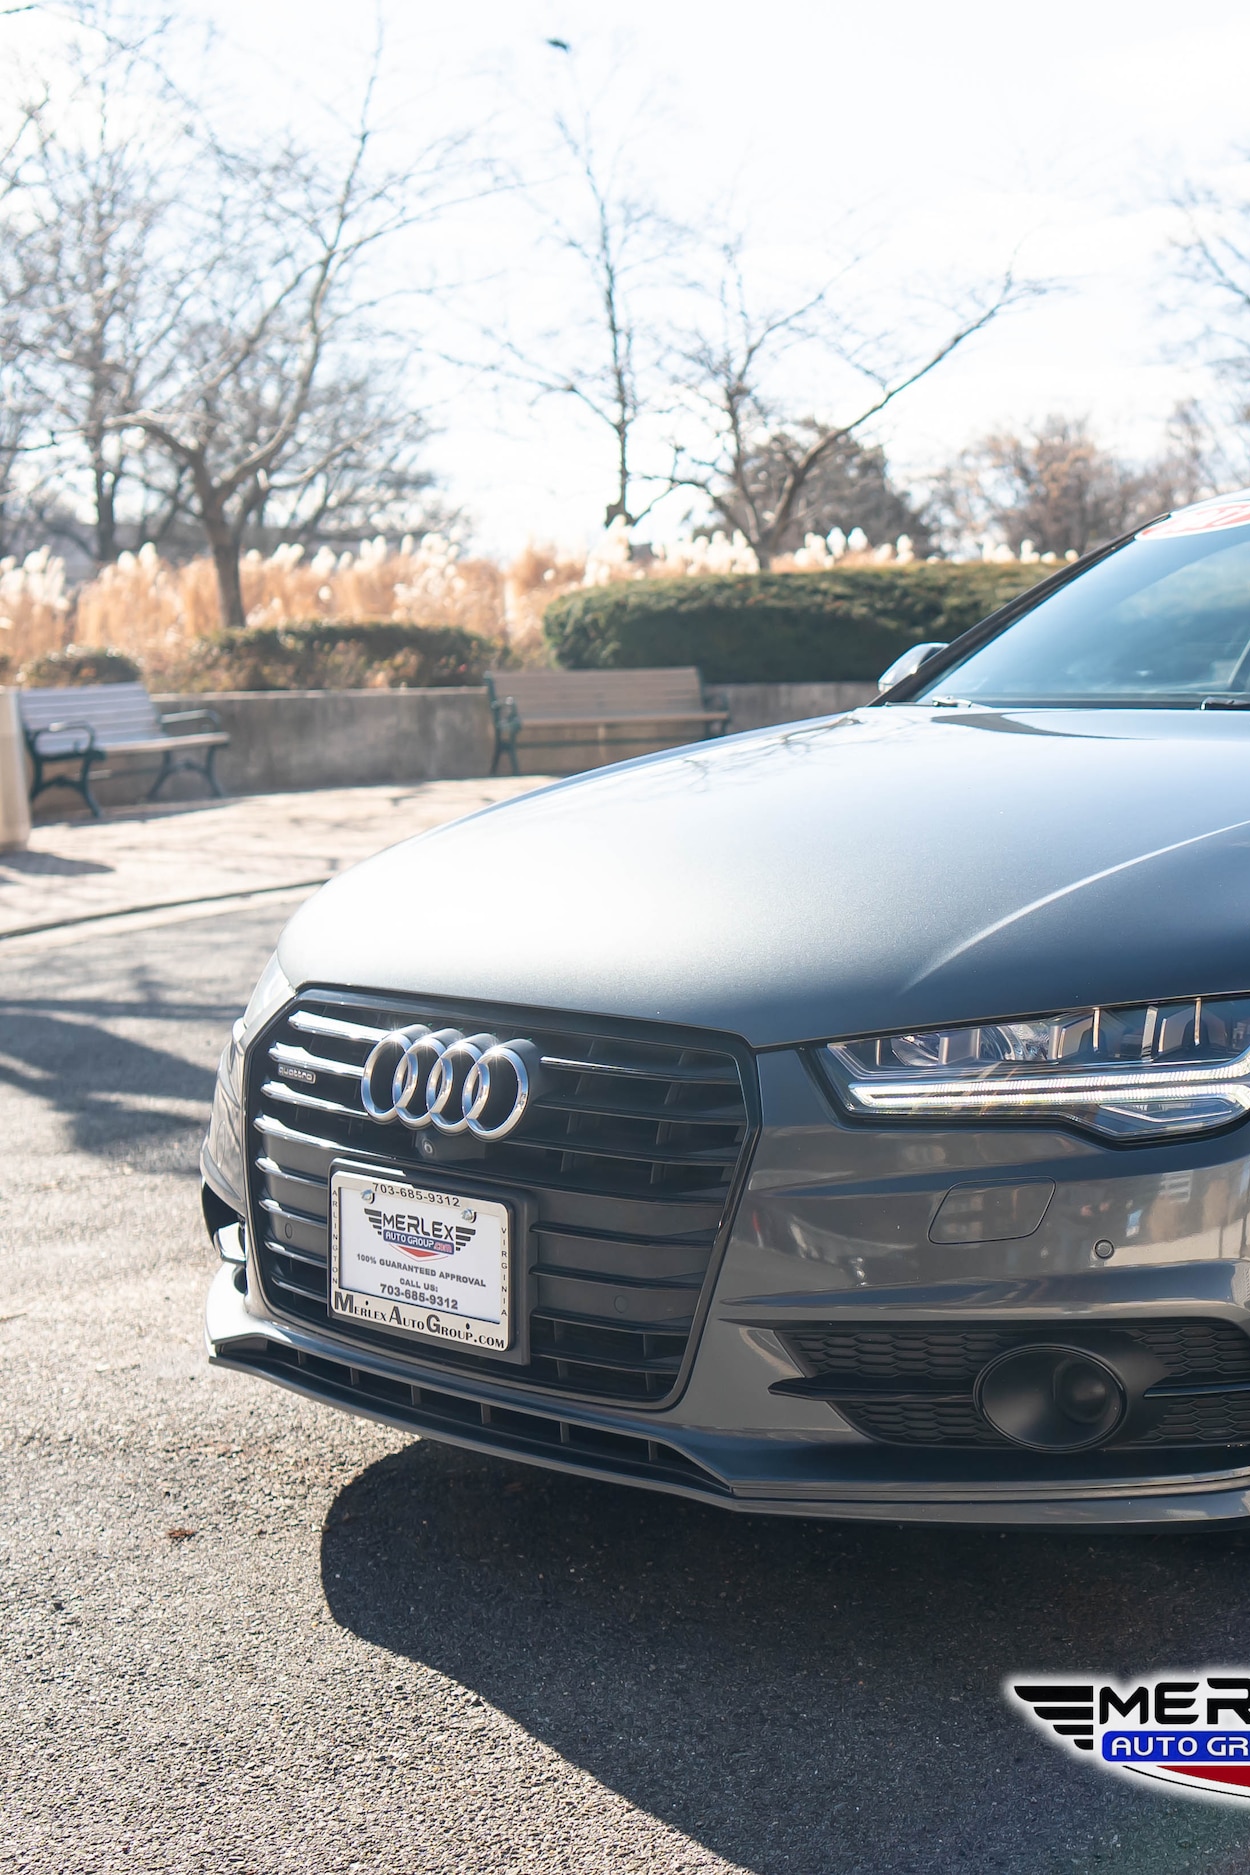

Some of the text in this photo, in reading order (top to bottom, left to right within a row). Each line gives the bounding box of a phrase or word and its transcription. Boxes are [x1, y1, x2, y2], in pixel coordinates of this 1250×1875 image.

[278, 1066, 313, 1081] quattro
[372, 1182, 460, 1207] 703-685-9312
[383, 1213, 454, 1241] MERLEX
[385, 1232, 407, 1243] AUTO
[357, 1253, 487, 1288] 100% GUARANTEED APPROVAL
[380, 1283, 459, 1310] 703-685-9312
[399, 1278, 438, 1293] CALL US:
